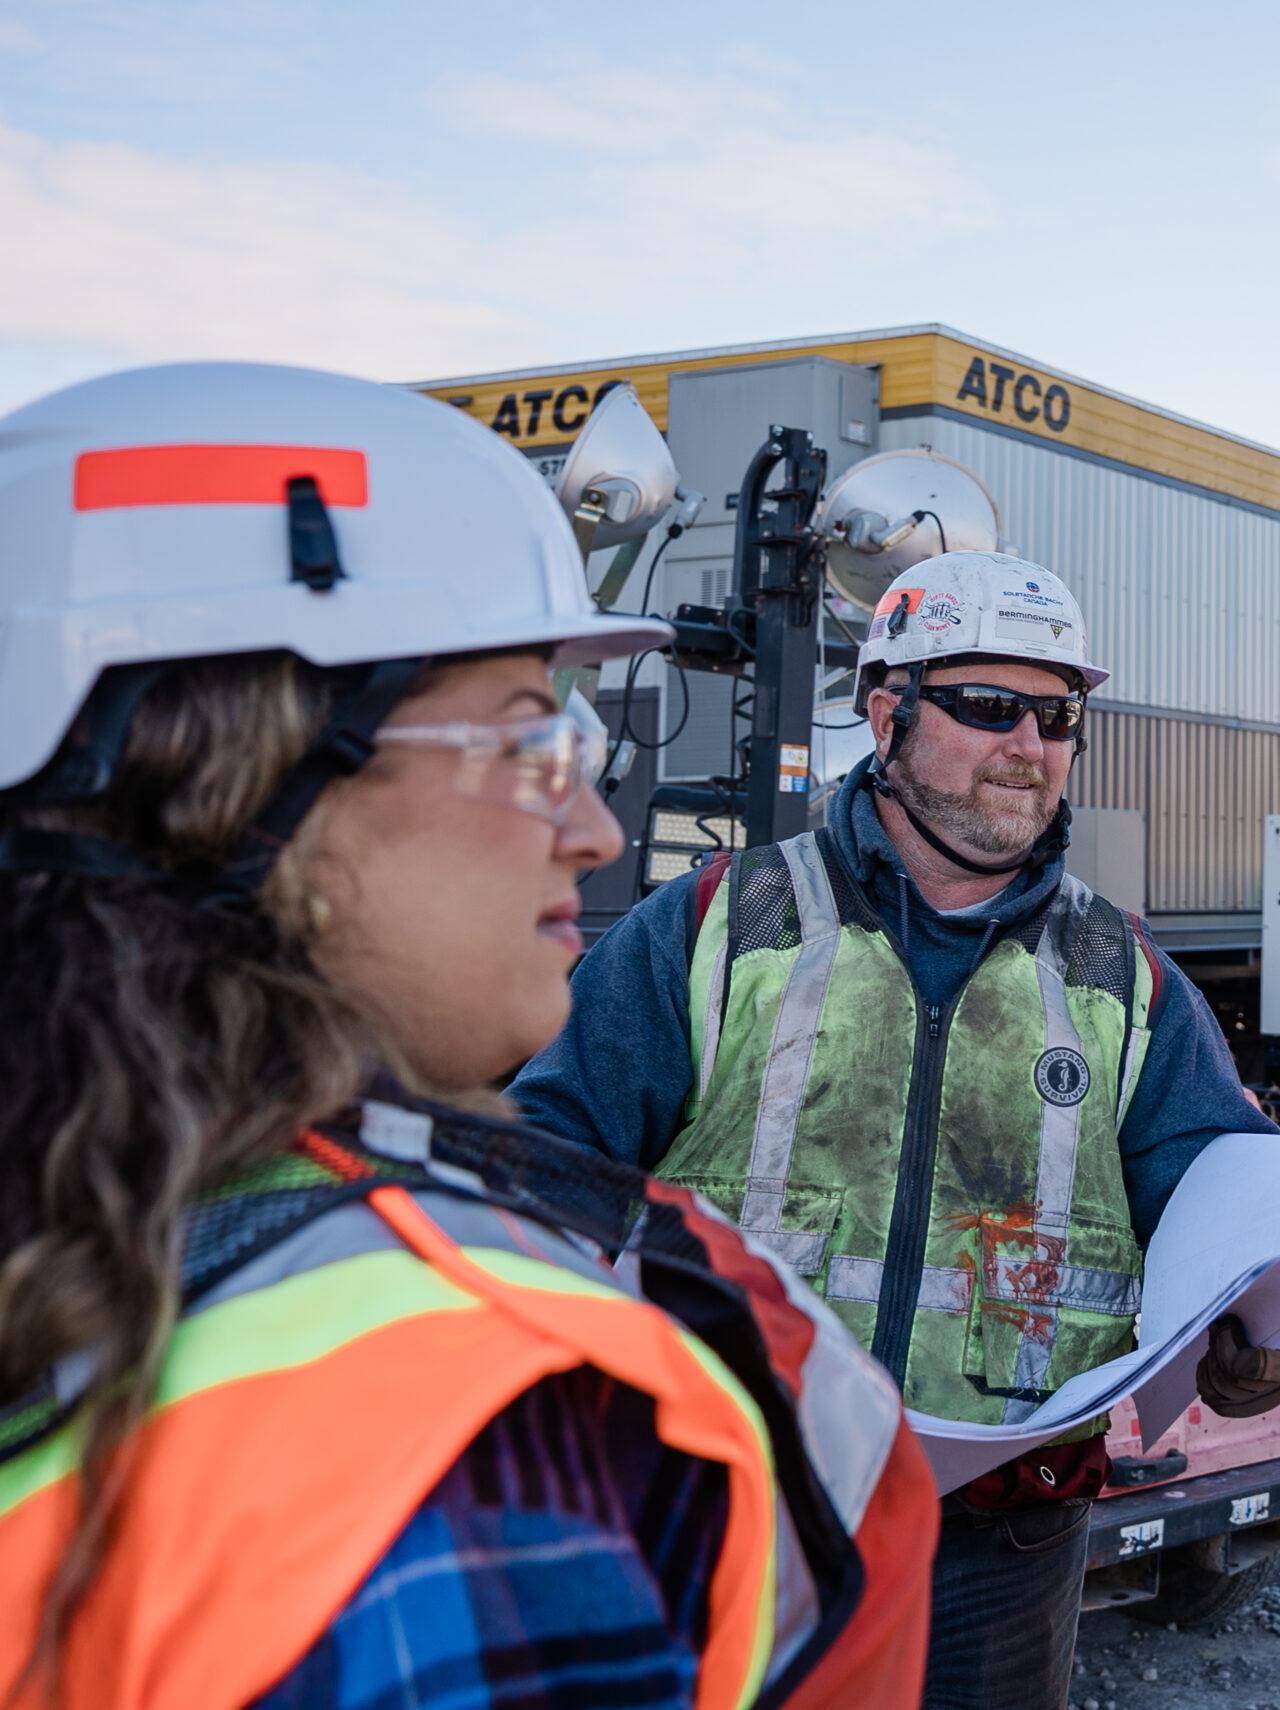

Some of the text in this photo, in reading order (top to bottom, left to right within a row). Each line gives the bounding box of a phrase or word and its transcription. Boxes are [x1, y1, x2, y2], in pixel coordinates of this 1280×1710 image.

[956, 357, 1070, 432] ATCO
[1040, 1051, 1086, 1074] MUSTANG
[1040, 1076, 1087, 1101] SURVIVAL
